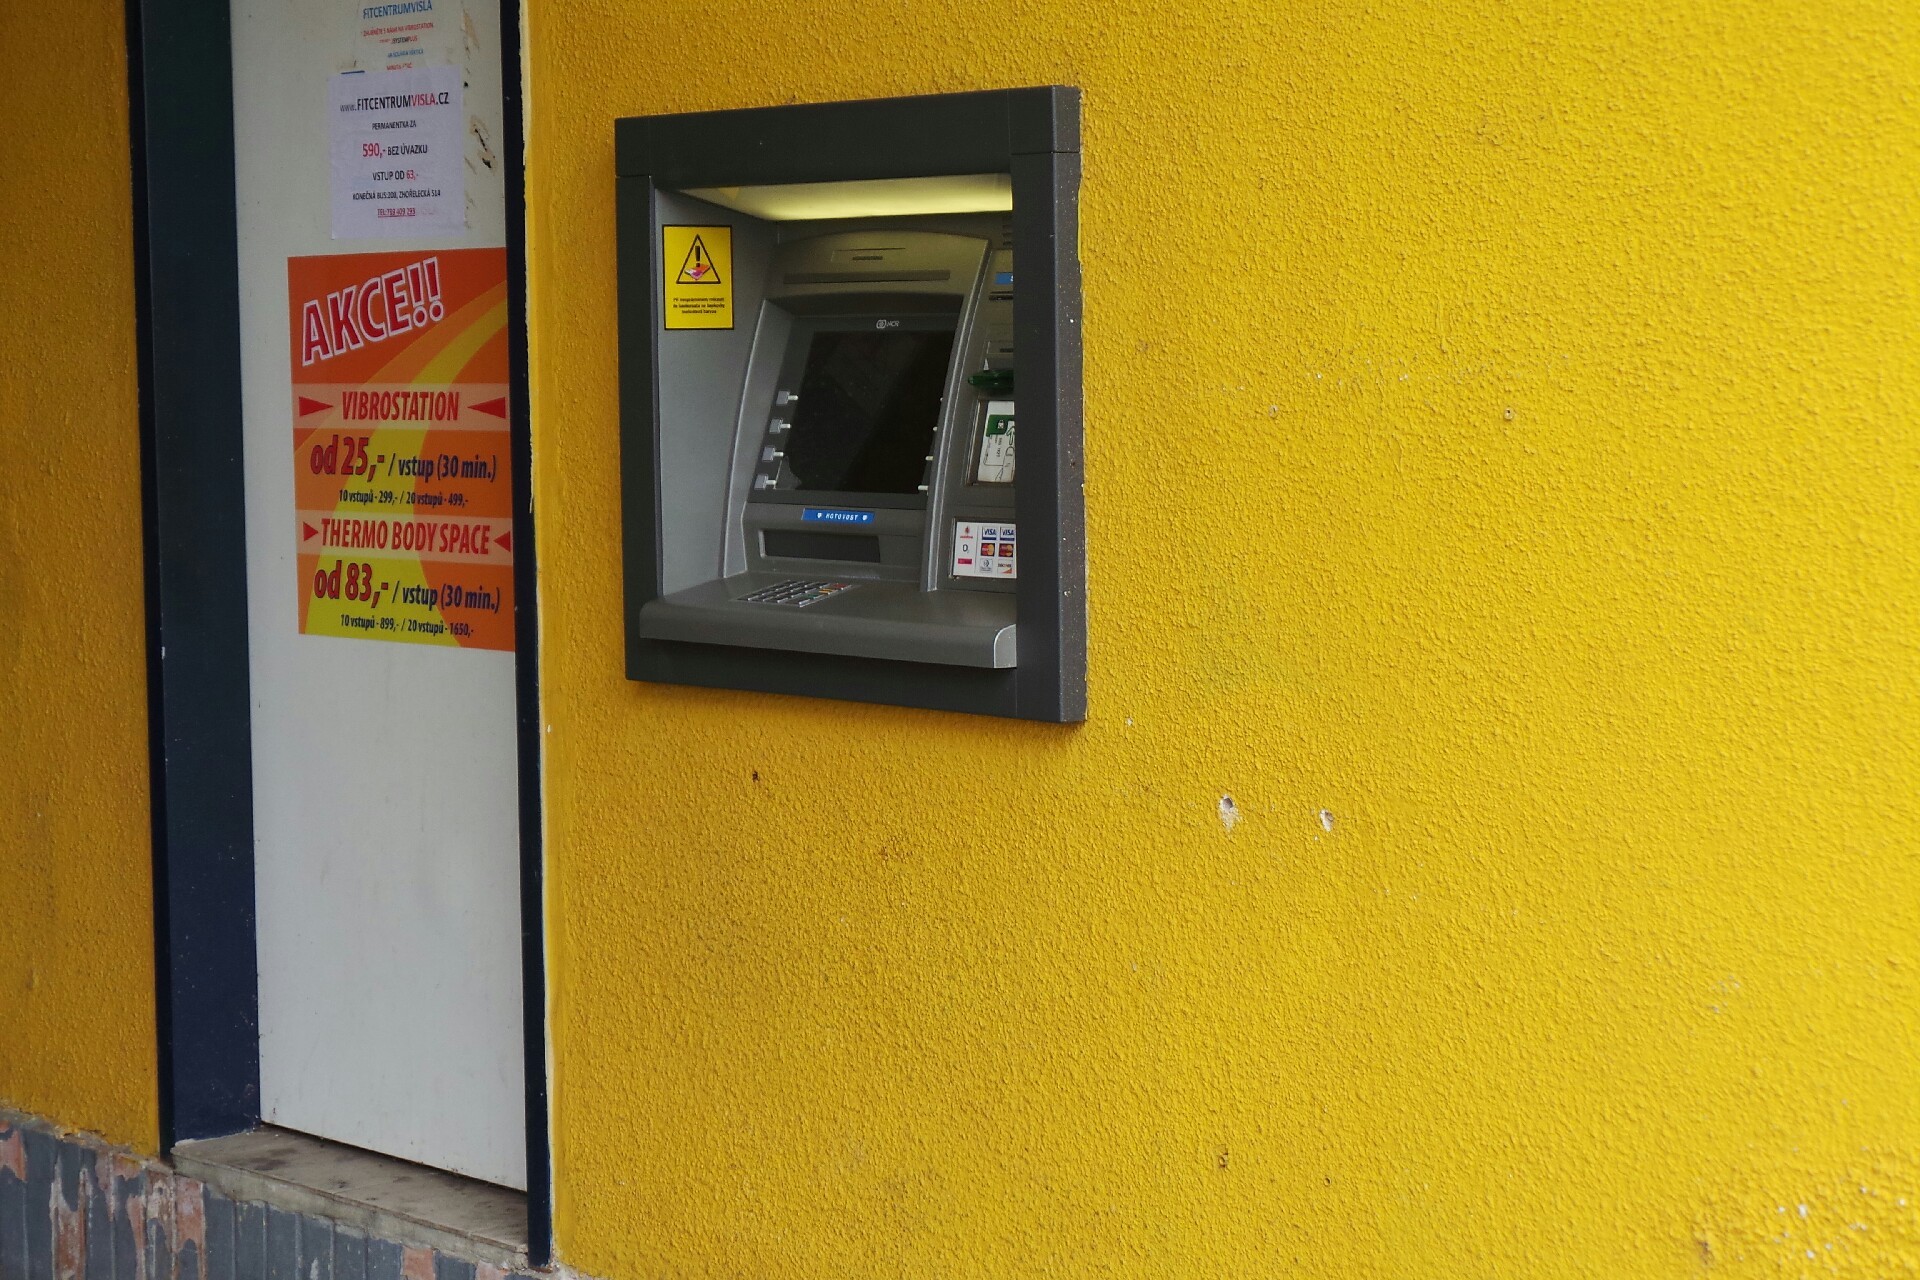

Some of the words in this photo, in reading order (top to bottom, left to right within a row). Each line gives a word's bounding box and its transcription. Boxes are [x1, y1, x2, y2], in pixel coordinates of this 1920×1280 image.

[363, 0, 433, 19] FITCENTRUMVISLA
[372, 121, 409, 130] PERMANENTKA
[409, 120, 417, 128] ZA
[362, 143, 386, 158] 590,-
[387, 146, 399, 156] BEZ
[400, 143, 428, 155] ÚVAZKU
[372, 171, 394, 181] VSTUP
[394, 170, 405, 180] OD
[302, 256, 444, 367] AKCE!!
[342, 390, 460, 421] VIBROSTATION
[310, 434, 338, 475] od
[340, 437, 385, 482] 25,-
[399, 455, 434, 483] vstup
[437, 454, 459, 480] (30
[461, 455, 497, 482] min.)
[339, 489, 349, 502] 10
[349, 489, 373, 506] vstupů
[378, 490, 398, 506] 299,-
[406, 491, 416, 505] 20
[416, 491, 443, 508] vstupů
[321, 518, 388, 549] THERMO
[391, 521, 438, 551] BODY
[439, 524, 490, 555] SPACE
[314, 560, 342, 600] od
[345, 563, 389, 608] 83,-
[402, 583, 438, 611] vstup
[440, 583, 462, 609] (30
[464, 585, 501, 614] min.)
[341, 614, 350, 627] 10
[350, 614, 375, 632] vstupů
[380, 616, 399, 632] 899,-
[407, 618, 417, 632] 20
[418, 619, 444, 636] vstupů
[450, 622, 474, 637] 1650,-
